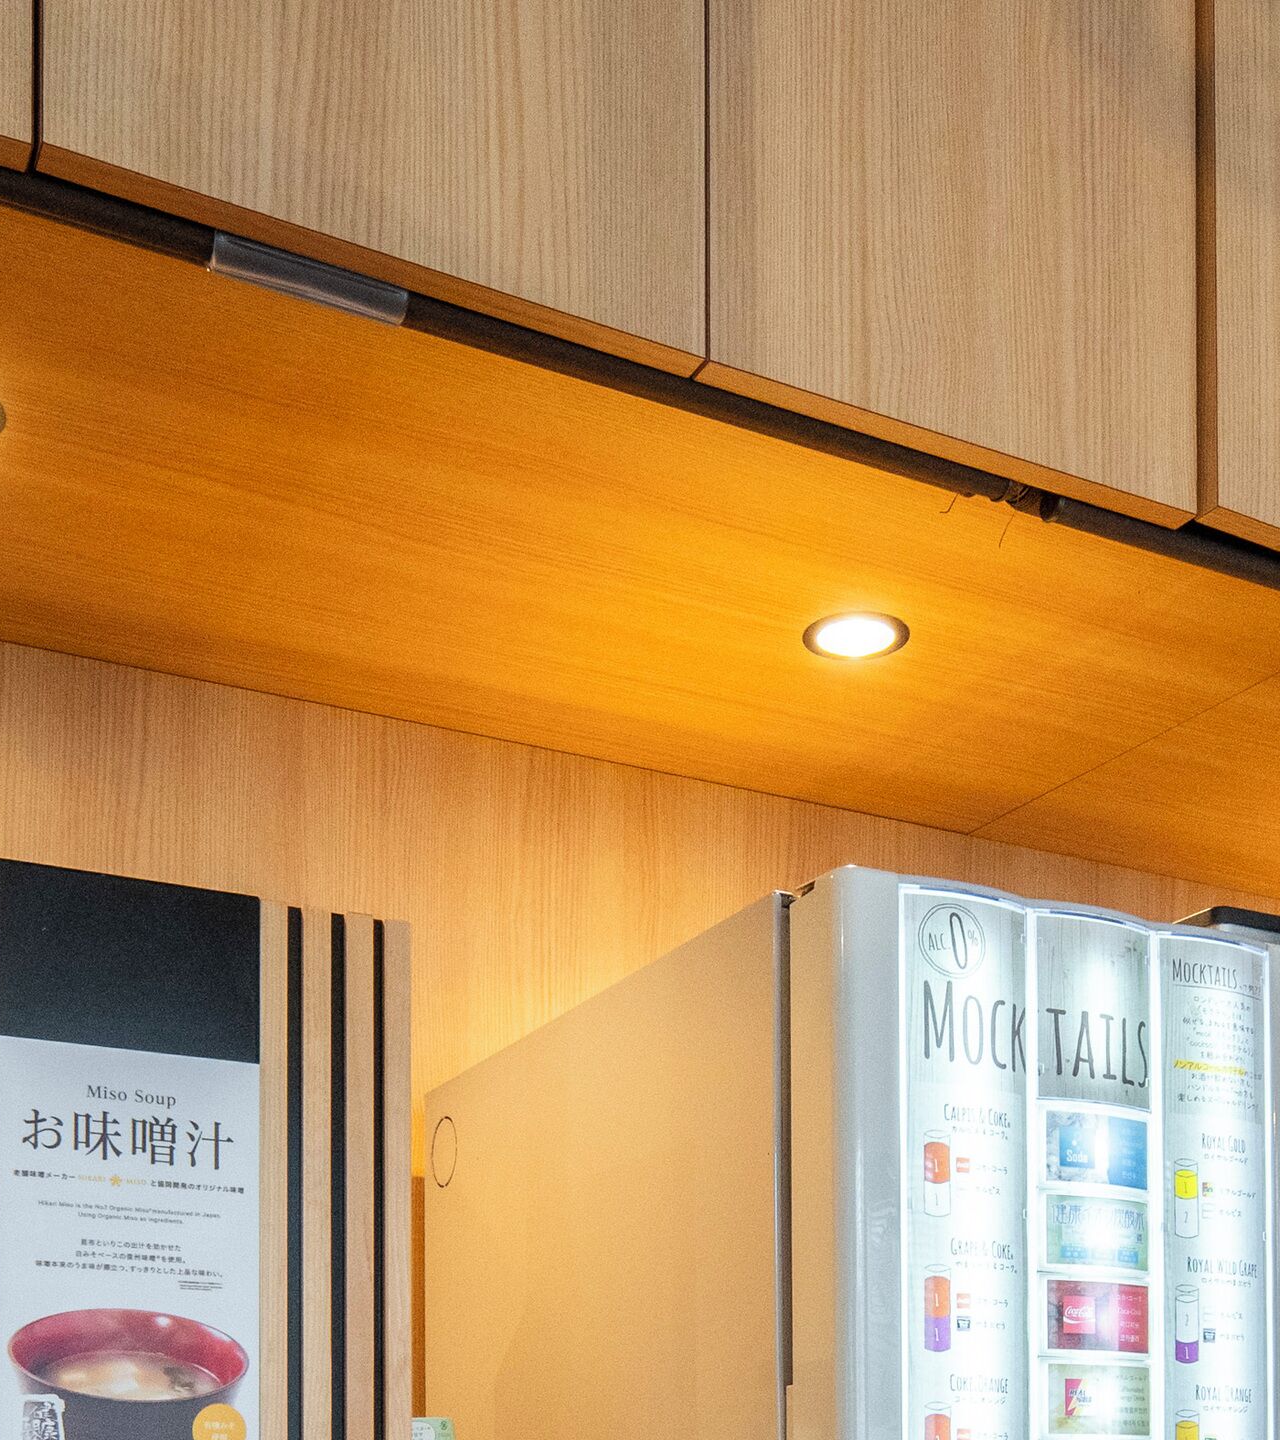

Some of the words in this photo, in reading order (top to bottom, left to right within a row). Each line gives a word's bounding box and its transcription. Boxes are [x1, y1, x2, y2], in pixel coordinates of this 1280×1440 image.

[1172, 957, 1237, 989] MOCKTAILS
[86, 1084, 127, 1102] Miso
[134, 1089, 177, 1109] Soup
[22, 1108, 235, 1171] お味噌汁
[1066, 1149, 1090, 1164] Soda
